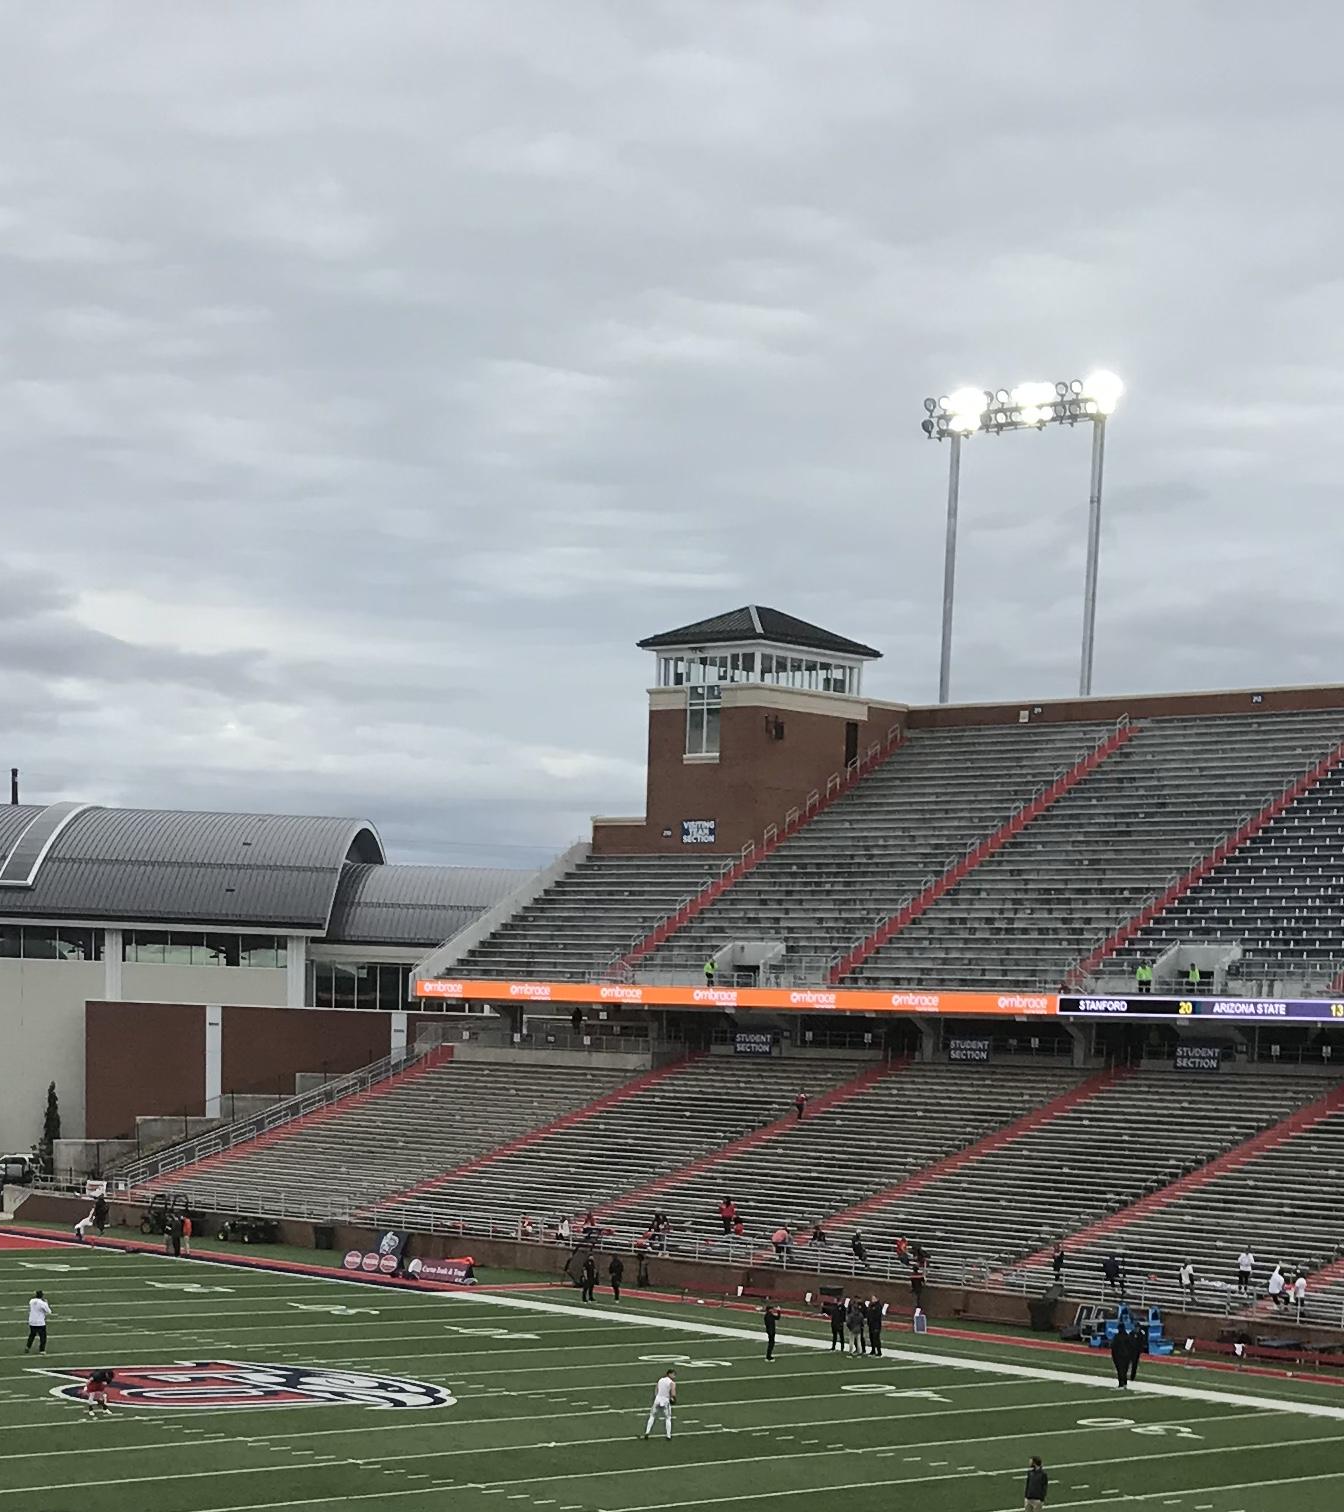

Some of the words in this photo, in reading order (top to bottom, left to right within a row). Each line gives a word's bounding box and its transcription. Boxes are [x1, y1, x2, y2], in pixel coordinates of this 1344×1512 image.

[683, 821, 714, 829] VISITING
[683, 835, 714, 843] SECTION
[600, 984, 642, 999] embrace
[693, 987, 737, 1001] embrace
[790, 990, 836, 1005] embrace
[891, 992, 939, 1007] embrace
[997, 994, 1047, 1010] embrace
[1079, 1000, 1127, 1012] STANFORD
[1179, 1001, 1193, 1014] 20
[1213, 1003, 1255, 1015] ARIZONA
[1256, 1003, 1286, 1015] STATE
[1330, 1004, 1344, 1017] 13
[736, 1033, 772, 1042] STUDENT
[736, 1044, 770, 1052] SECTION
[950, 1040, 990, 1049] STUDENT
[950, 1050, 988, 1060] SECTION
[1176, 1047, 1220, 1057] STUDENT
[1176, 1057, 1217, 1068] SECTION
